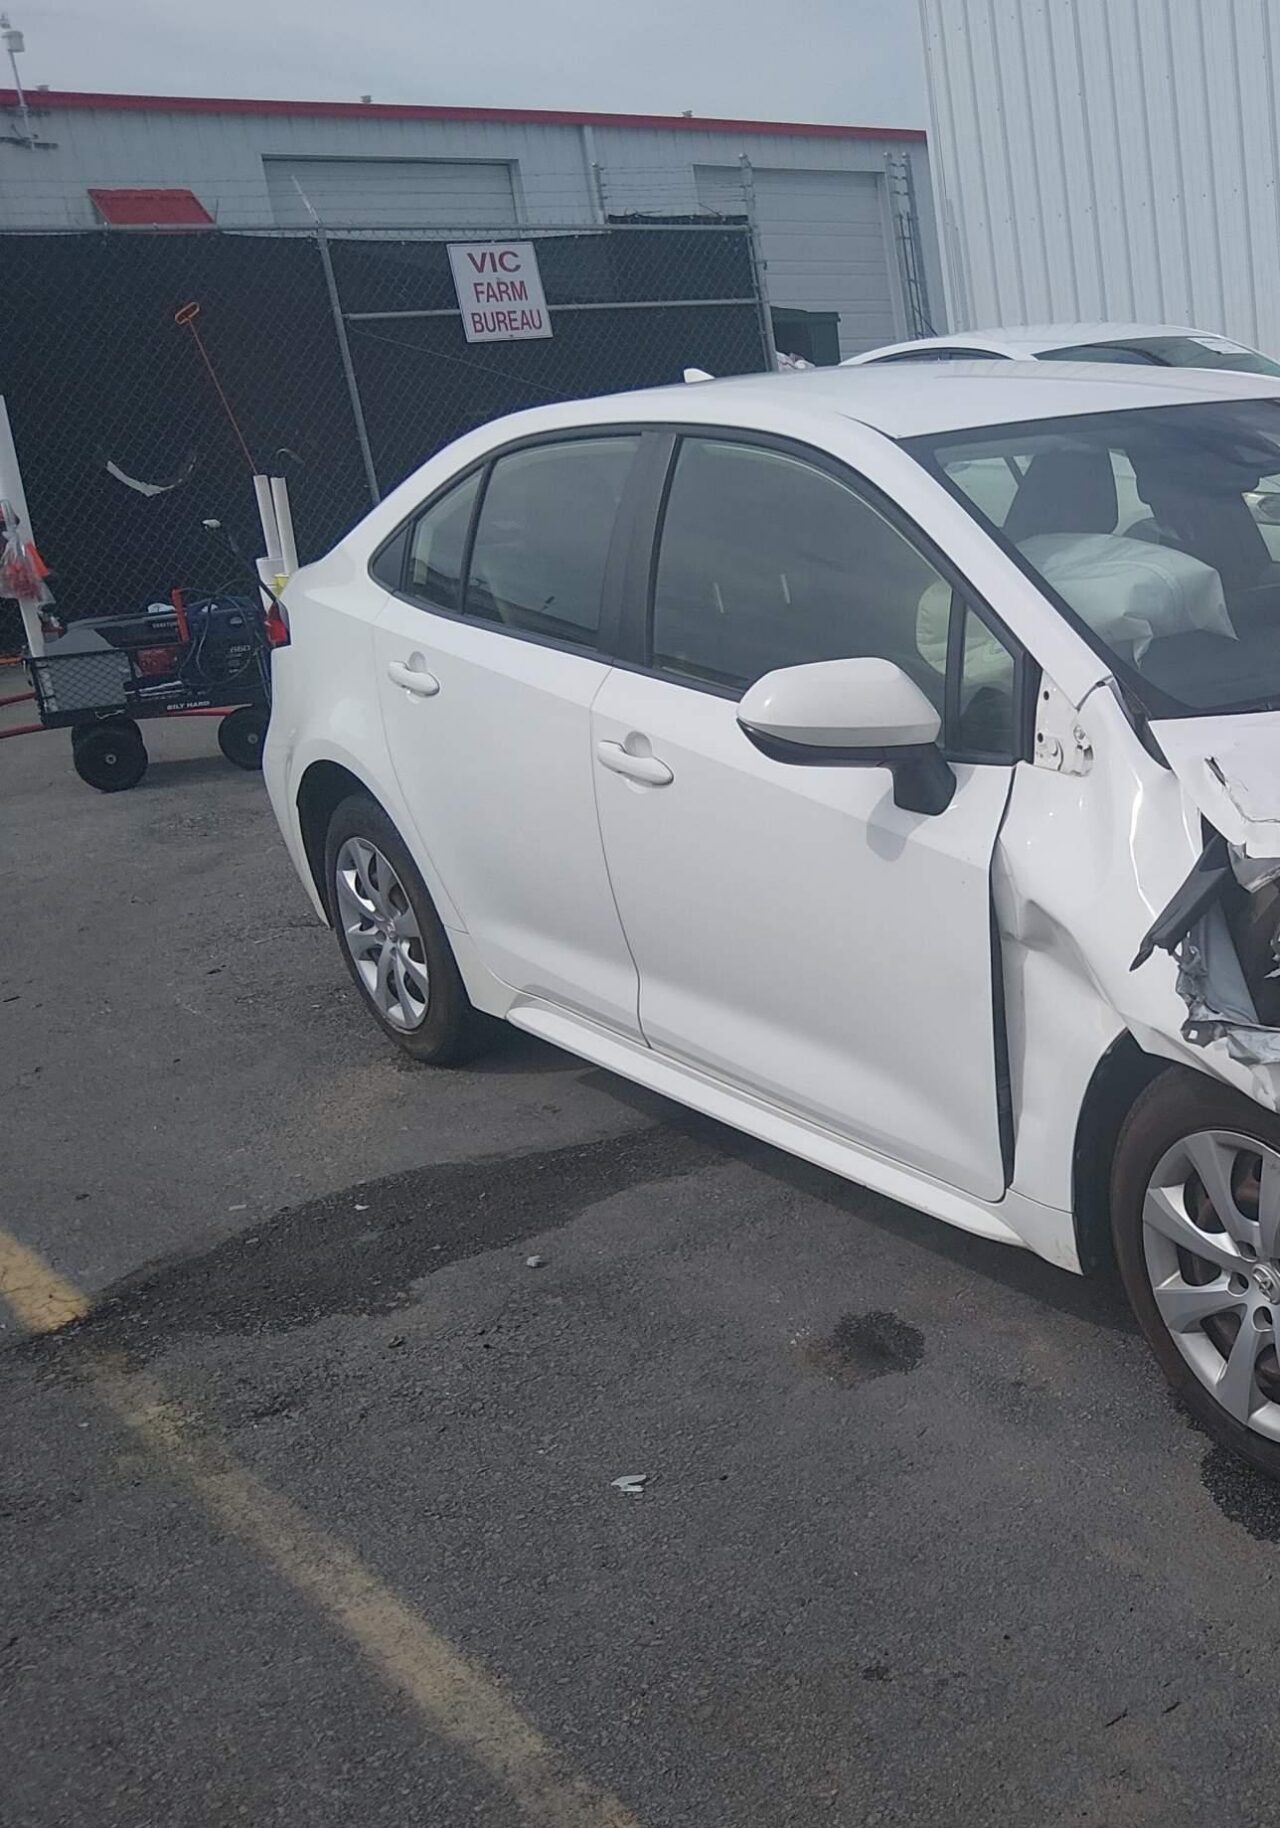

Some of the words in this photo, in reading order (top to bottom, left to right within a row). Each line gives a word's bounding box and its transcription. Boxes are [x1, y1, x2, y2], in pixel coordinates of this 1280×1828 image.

[467, 250, 521, 273] VIC
[473, 280, 528, 303] FARM
[471, 309, 543, 333] BUREAU
